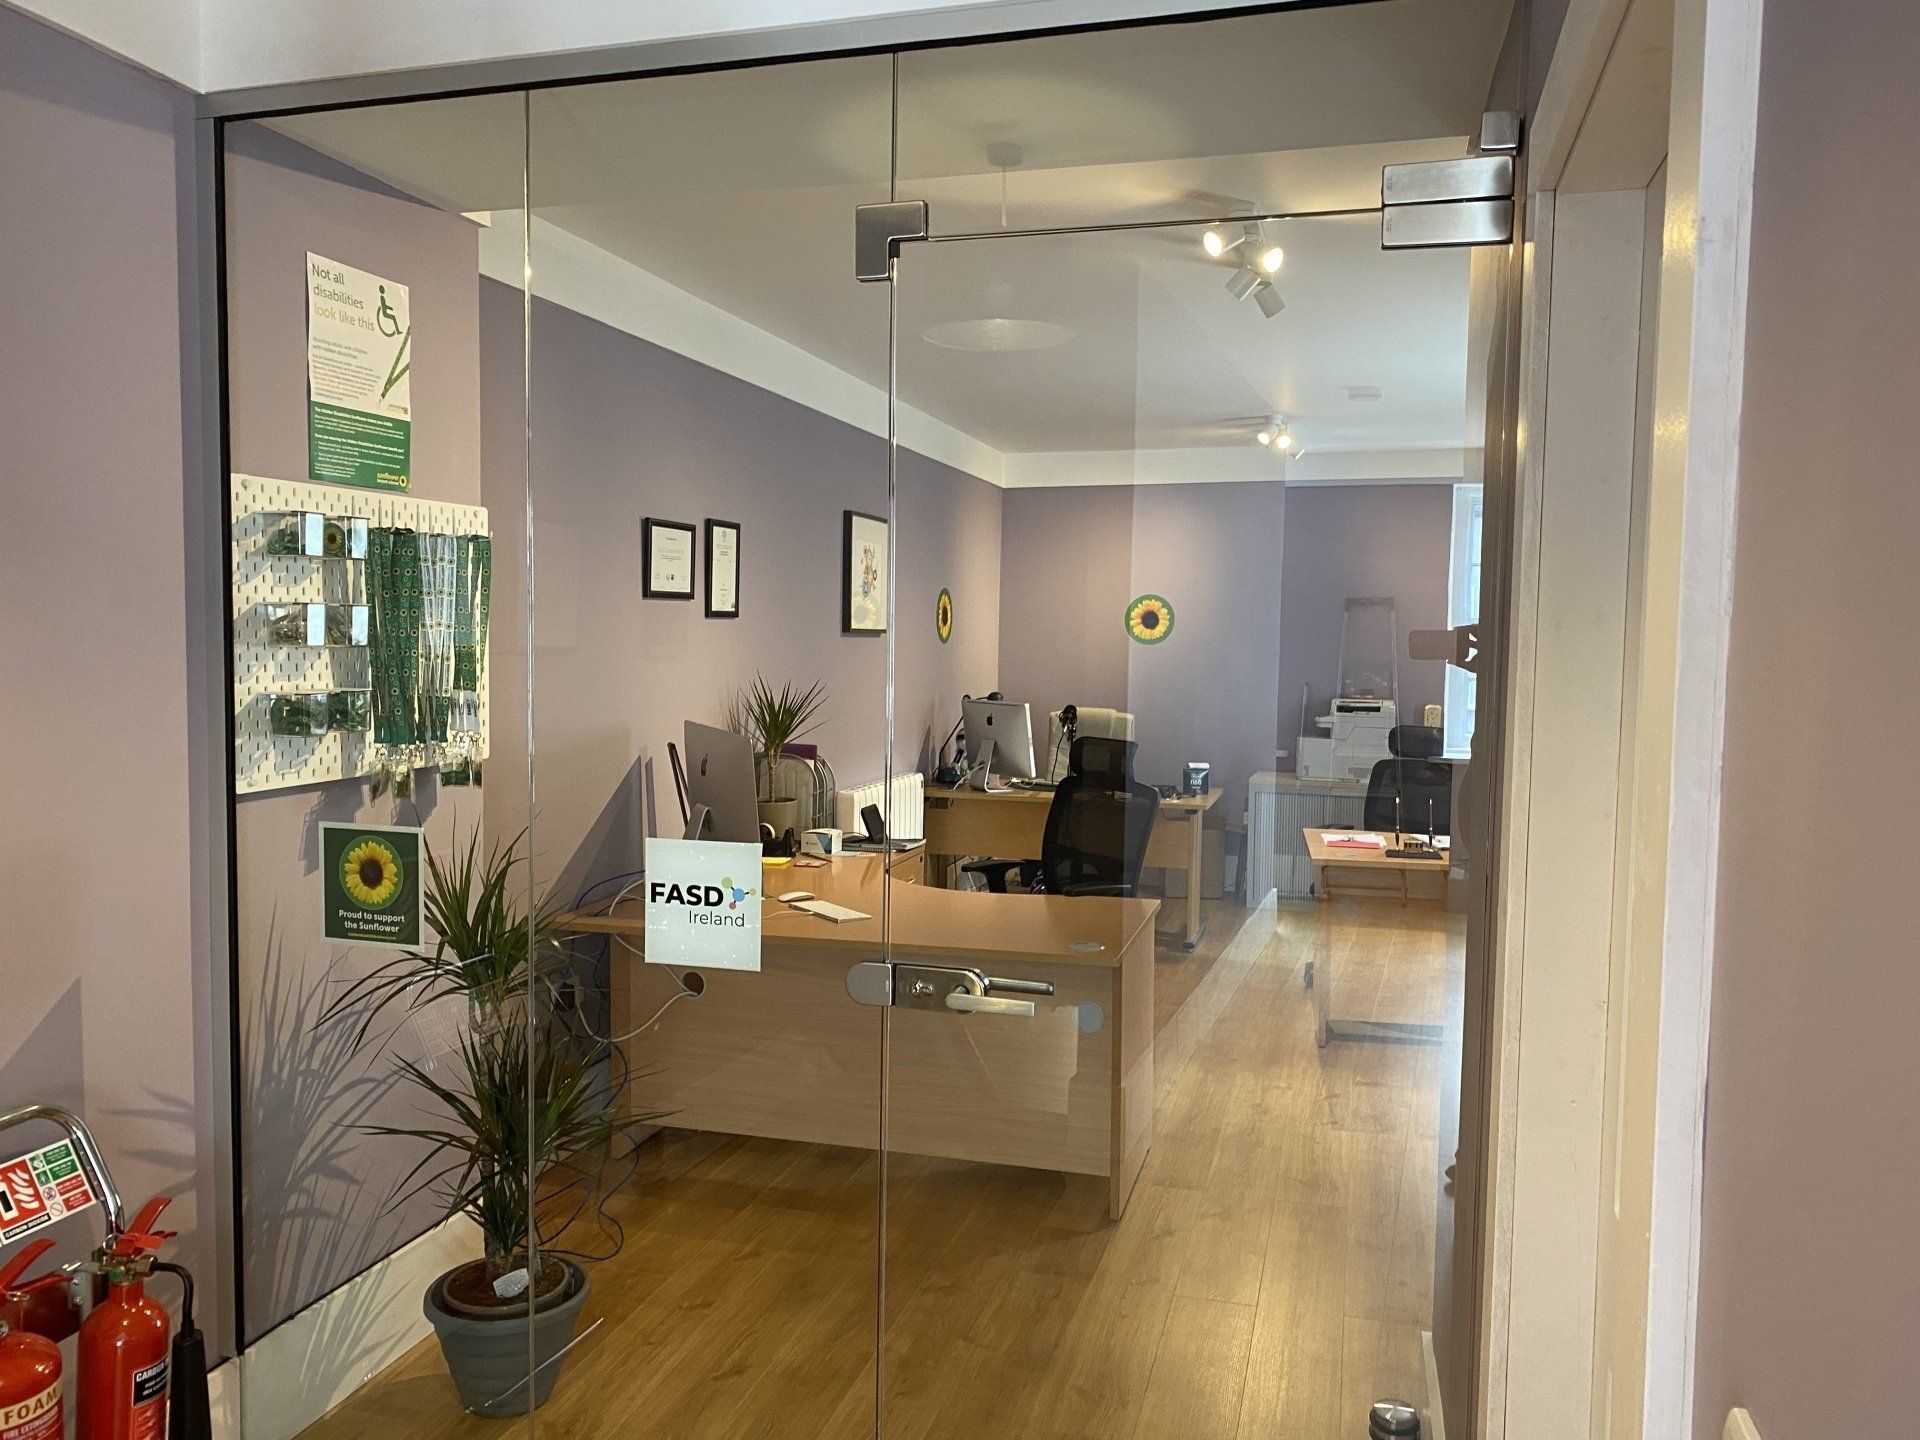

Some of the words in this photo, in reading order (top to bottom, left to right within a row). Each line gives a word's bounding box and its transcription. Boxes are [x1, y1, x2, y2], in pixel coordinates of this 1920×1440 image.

[312, 263, 331, 281] Not
[333, 272, 345, 285] all
[313, 284, 364, 310] disabilities
[314, 302, 337, 321] look
[339, 309, 356, 326] like
[358, 316, 375, 331] this
[338, 910, 362, 919] Proud
[363, 911, 372, 920] to
[373, 914, 405, 923] support
[650, 882, 724, 907] FASD
[689, 910, 745, 927] Ireland
[344, 921, 358, 929] the
[359, 922, 400, 932] Sunflower
[4, 1387, 57, 1425] FOAM
